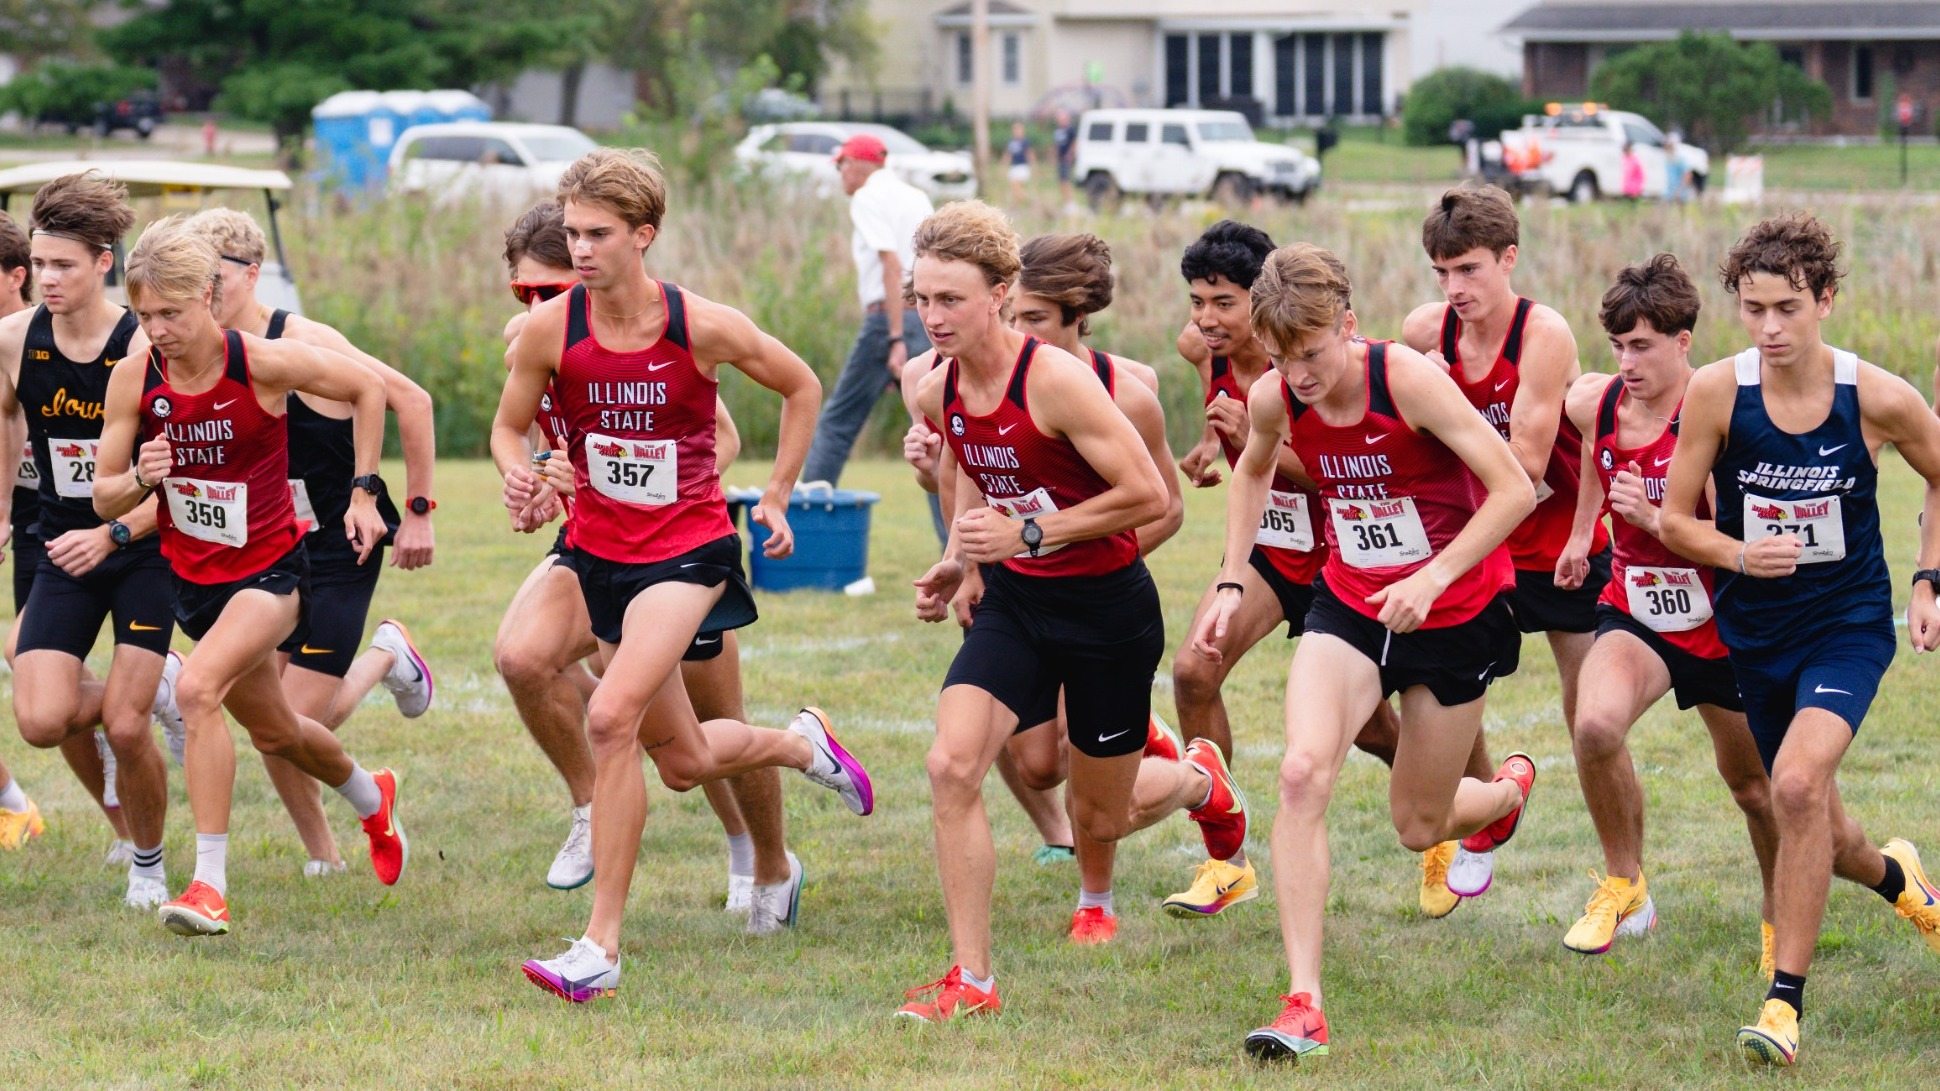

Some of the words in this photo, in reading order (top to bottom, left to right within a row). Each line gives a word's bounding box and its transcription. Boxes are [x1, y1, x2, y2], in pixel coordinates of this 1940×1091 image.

[41, 387, 106, 420] Iow
[588, 382, 667, 405] ILLINOIS
[164, 419, 234, 443] ILLINOIS
[600, 410, 654, 431] STATE
[176, 445, 226, 466] STATE
[633, 444, 667, 460] VALLEY
[963, 443, 1020, 469] ILLINOIS
[69, 461, 97, 482] 28
[606, 460, 655, 487] 357
[1319, 454, 1392, 479] ILLINOIS
[1755, 462, 1840, 479] ILLINOIS
[980, 473, 1024, 494] STATE
[1737, 469, 1857, 492] SPRINGFIELD
[206, 484, 237, 501] VALLEY
[1271, 493, 1298, 509] VALLEY
[1337, 483, 1389, 500] STATE
[185, 500, 227, 529] 359
[1369, 500, 1405, 519] VALLEY
[1793, 501, 1830, 519] VALLEY
[1260, 509, 1296, 533] 365
[1353, 523, 1403, 551] 361
[1662, 570, 1692, 585] VALLEY
[1646, 588, 1692, 616] 360
